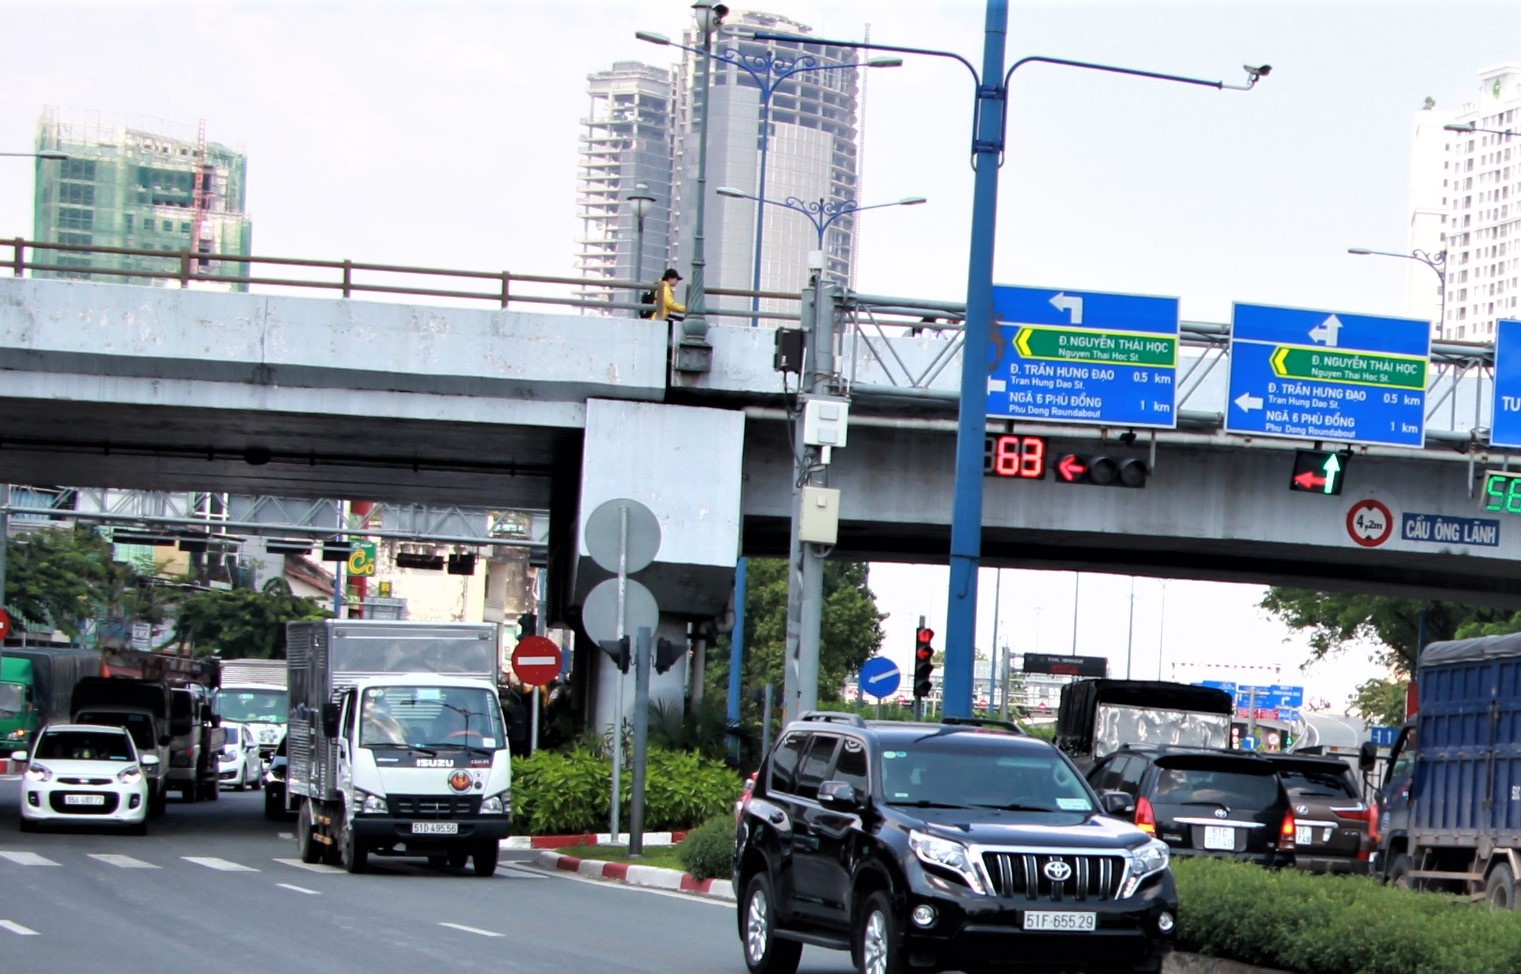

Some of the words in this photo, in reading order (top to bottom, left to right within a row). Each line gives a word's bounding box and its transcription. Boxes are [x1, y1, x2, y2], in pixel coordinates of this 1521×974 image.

[1119, 338, 1143, 351] THÁI
[1147, 341, 1169, 354] HỌC
[1059, 348, 1090, 359] Nguyen
[1094, 351, 1110, 360] Thai
[1113, 352, 1128, 361] Hoc
[1130, 353, 1140, 361] St.
[1010, 364, 1021, 374] Đ.
[1025, 363, 1055, 376] TRẦN
[1057, 367, 1089, 378] HƯNG
[1091, 369, 1114, 382] ĐẠO
[1312, 355, 1322, 366] Đ.
[1324, 355, 1367, 369] NGUYỄN
[1370, 359, 1393, 371] THÁI
[1397, 362, 1417, 376] HỌC
[1133, 372, 1148, 383] 0.5
[1155, 374, 1171, 384] km
[1311, 368, 1342, 379] Nguyen
[1344, 370, 1361, 379] Thai
[1363, 372, 1378, 381] Hoc
[1380, 374, 1390, 382] St.
[1011, 377, 1030, 386] Tran
[1032, 378, 1054, 389] Hung
[1056, 379, 1072, 388] Dao
[1074, 381, 1085, 390] St.
[1010, 391, 1033, 403] NGÃ
[1037, 393, 1043, 403] 6
[1046, 394, 1068, 405] PHÙ
[1268, 382, 1279, 393] Đ.
[1282, 382, 1311, 395] TRẦN
[1313, 386, 1343, 399] HƯNG
[1345, 389, 1366, 402] ĐẠO
[1383, 393, 1398, 404] 0.5
[1404, 395, 1420, 405] km
[1140, 400, 1145, 410] 1
[1154, 401, 1169, 412] km
[1269, 395, 1290, 404] Tran
[1292, 396, 1310, 407] Hung
[1312, 398, 1327, 407] Dao
[1329, 400, 1340, 409] St.
[1010, 405, 1025, 414] Phu
[1028, 407, 1050, 418] Dong
[1052, 408, 1101, 418] Roundabout
[1267, 410, 1289, 422] NGÃ
[1293, 412, 1299, 423] 6
[1301, 413, 1322, 425] PHÙ
[1266, 423, 1282, 432] Phu
[1286, 425, 1306, 436] Dong
[1308, 426, 1355, 438] Roundabout
[1390, 421, 1395, 431] 1
[1402, 423, 1418, 433] km
[997, 436, 1043, 477] 63
[1406, 516, 1431, 540] CẦU
[1434, 520, 1460, 541] ÔNG
[1464, 521, 1496, 544] LÃNH
[417, 759, 454, 767] ISUZU
